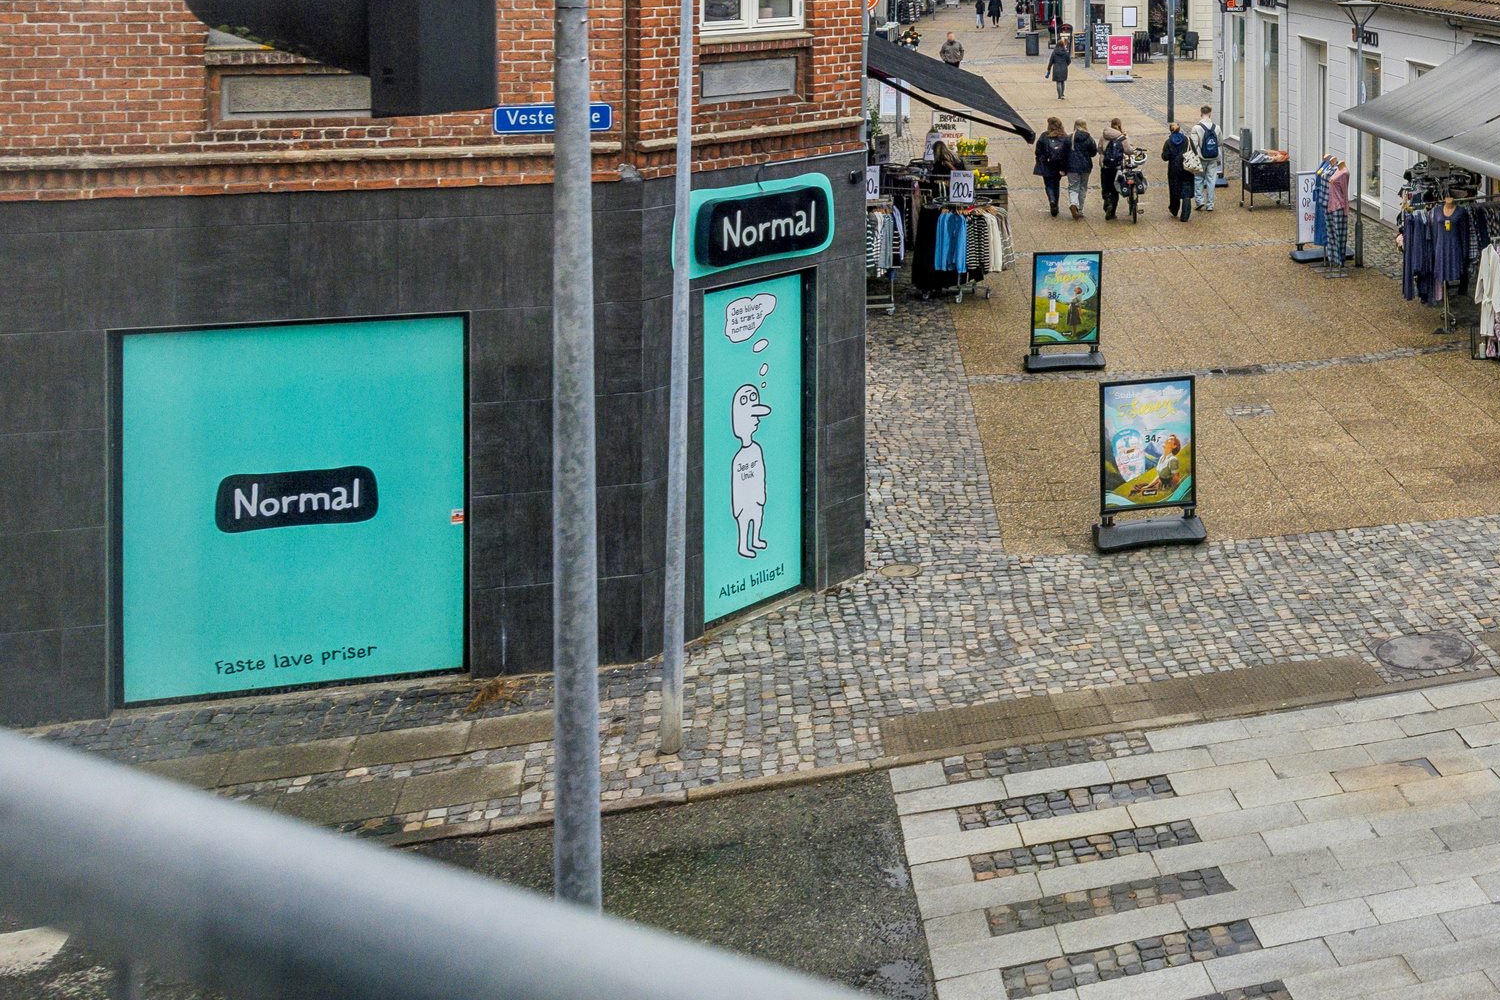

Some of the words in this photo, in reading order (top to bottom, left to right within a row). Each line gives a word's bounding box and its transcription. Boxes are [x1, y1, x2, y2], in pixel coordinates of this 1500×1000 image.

[506, 110, 601, 125] Vestee
[723, 200, 816, 251] Normal
[234, 478, 360, 520] Normal
[719, 578, 745, 599] Altid
[750, 563, 784, 587] billigt!
[215, 656, 266, 675] Faste
[274, 654, 313, 668] lave
[321, 645, 377, 665] priser
